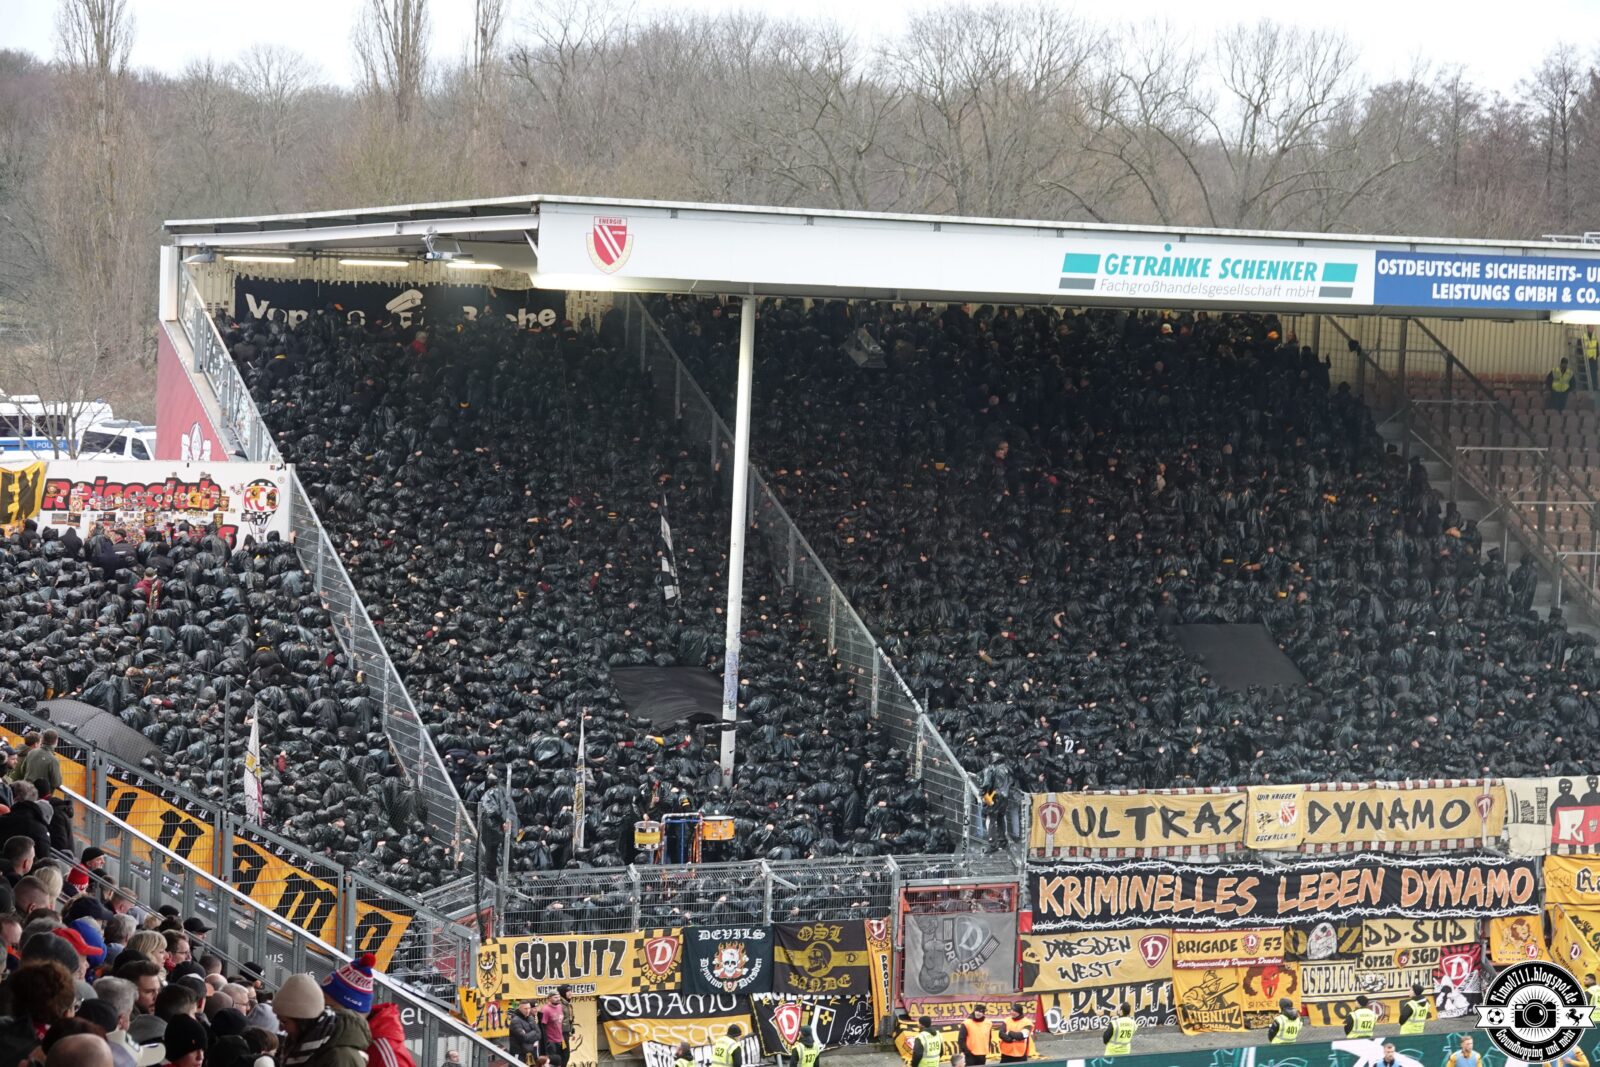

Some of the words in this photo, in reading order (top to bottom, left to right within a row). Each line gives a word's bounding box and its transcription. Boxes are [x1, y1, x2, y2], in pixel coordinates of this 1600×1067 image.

[1218, 258, 1318, 281] SCHENKER
[1377, 258, 1481, 279] OSTDEUTSCHE
[1485, 262, 1583, 283] SICHERHEITS-
[1100, 278, 1281, 298] Fachgroßhandelsgesellschaft
[1285, 285, 1316, 298] mbH
[1431, 282, 1511, 302] LEISTUNGS
[1514, 286, 1558, 303] GMBH
[1561, 287, 1572, 303] &
[1576, 287, 1600, 304] CO.
[1071, 799, 1245, 842] ULTRAS
[1307, 798, 1471, 835] DYNAMO
[1038, 875, 1261, 919] KRIMINELLES
[1277, 867, 1386, 914] LEBEN
[1400, 867, 1535, 910] DYNAMO
[698, 928, 766, 941] DEVILS
[1176, 939, 1238, 954] BRIGADE
[1262, 936, 1282, 951] 53
[513, 937, 628, 982] GÖRLITZ
[1042, 935, 1132, 961] DRESDEN
[1356, 953, 1393, 969] Forza
[1412, 948, 1439, 965] SGD
[1057, 959, 1122, 983] WEST
[1119, 1030, 1132, 1039] 276
[1286, 1026, 1298, 1035] 401
